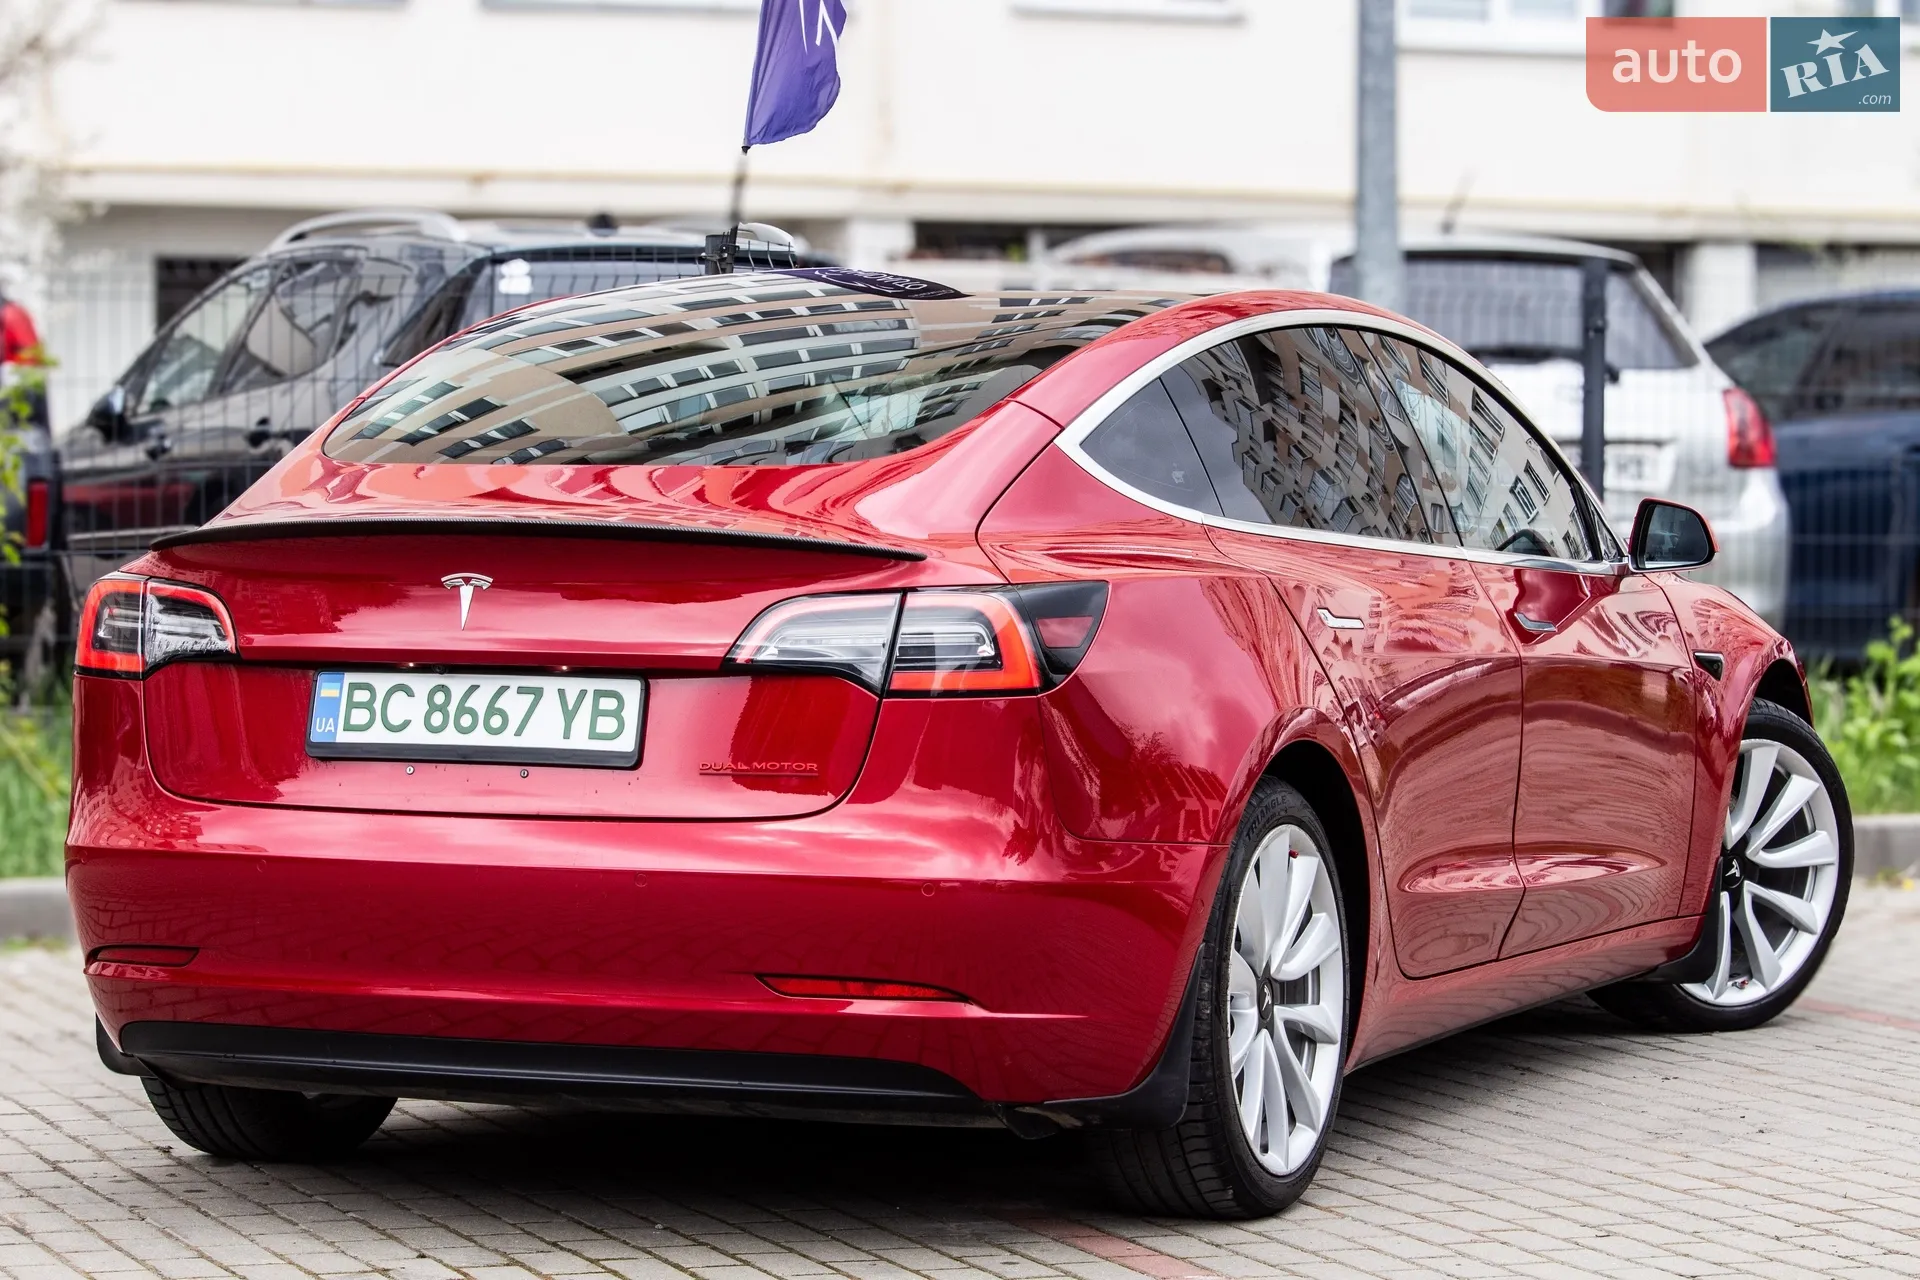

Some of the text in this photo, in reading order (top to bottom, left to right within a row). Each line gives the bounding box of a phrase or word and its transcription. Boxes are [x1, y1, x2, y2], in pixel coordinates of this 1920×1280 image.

[315, 717, 335, 733] UA
[343, 682, 625, 741] BC 8667 YB
[699, 761, 818, 772] DUAL MOTOR
[1246, 795, 1288, 841] TRIANGLE
